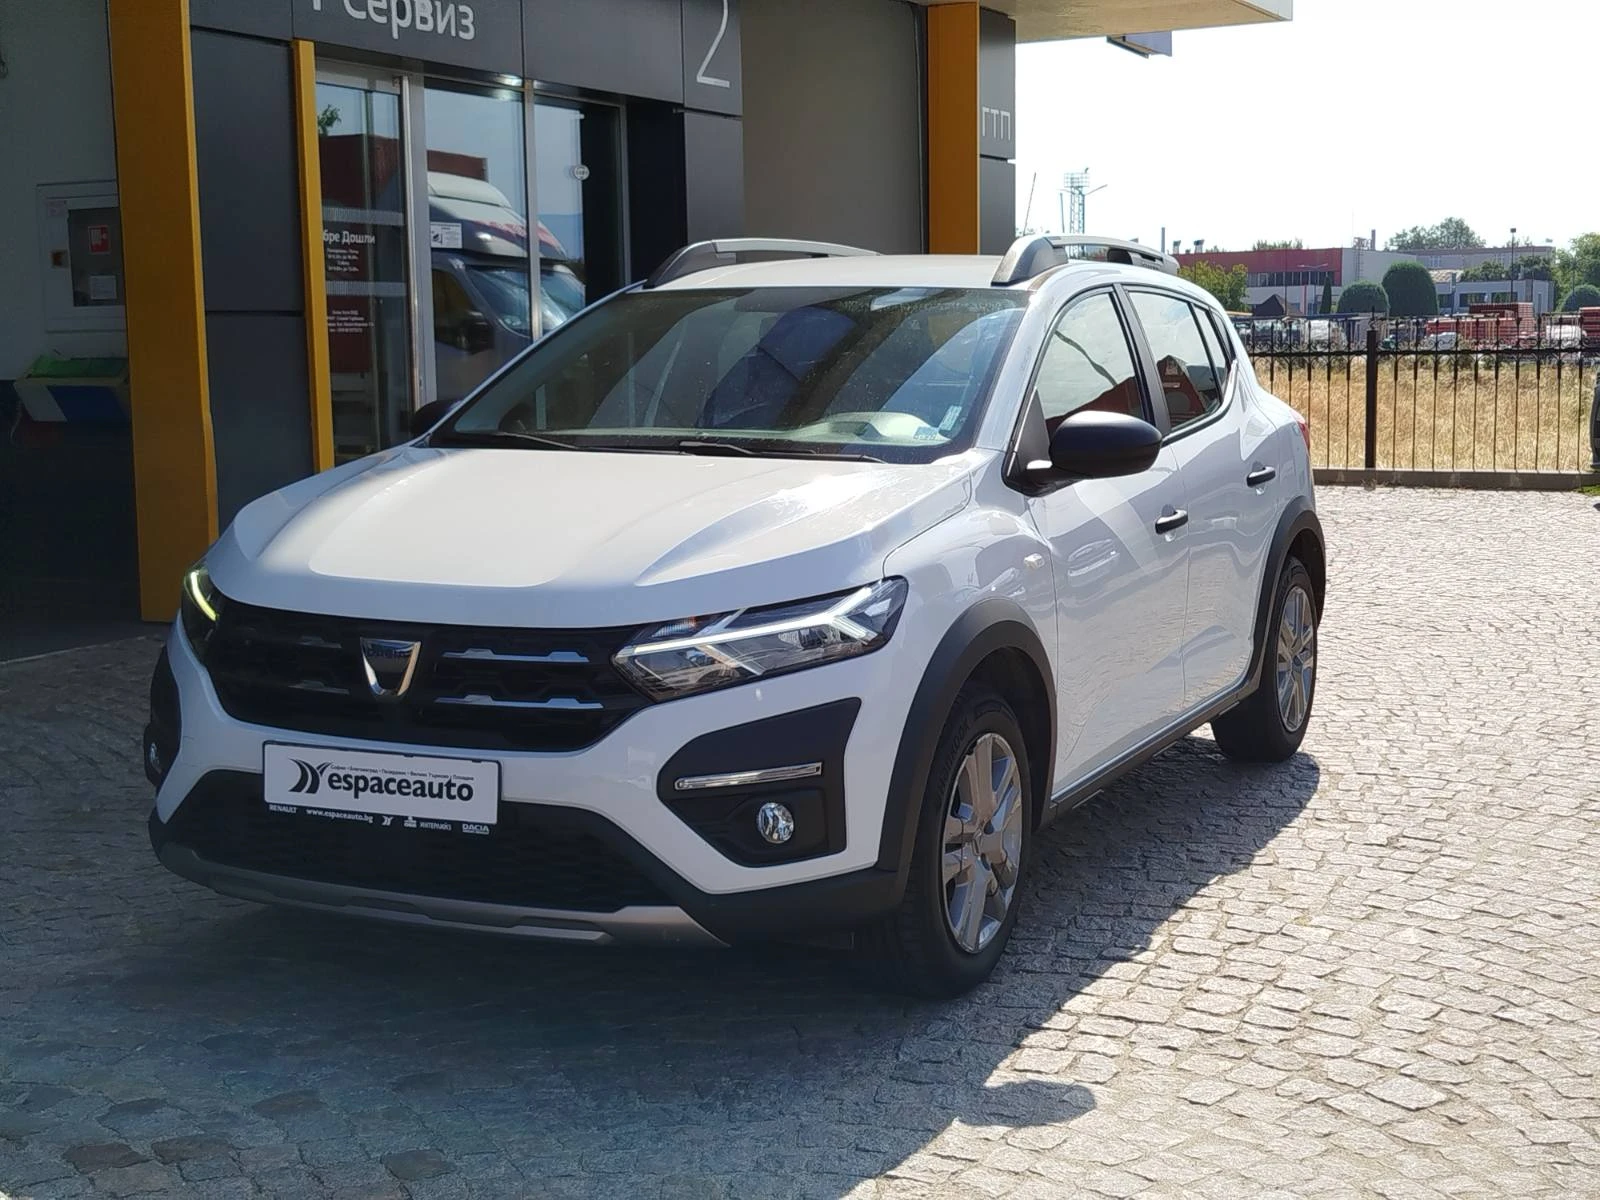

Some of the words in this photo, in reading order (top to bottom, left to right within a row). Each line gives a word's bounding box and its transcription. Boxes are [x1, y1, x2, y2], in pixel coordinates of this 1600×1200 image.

[982, 106, 1011, 141] ГТП
[342, 230, 376, 246] Дошли
[328, 772, 474, 801] espaceauto
[268, 804, 297, 814] RENAULT
[306, 809, 373, 824] www.espaceauto.bg
[462, 823, 489, 832] DACIA
